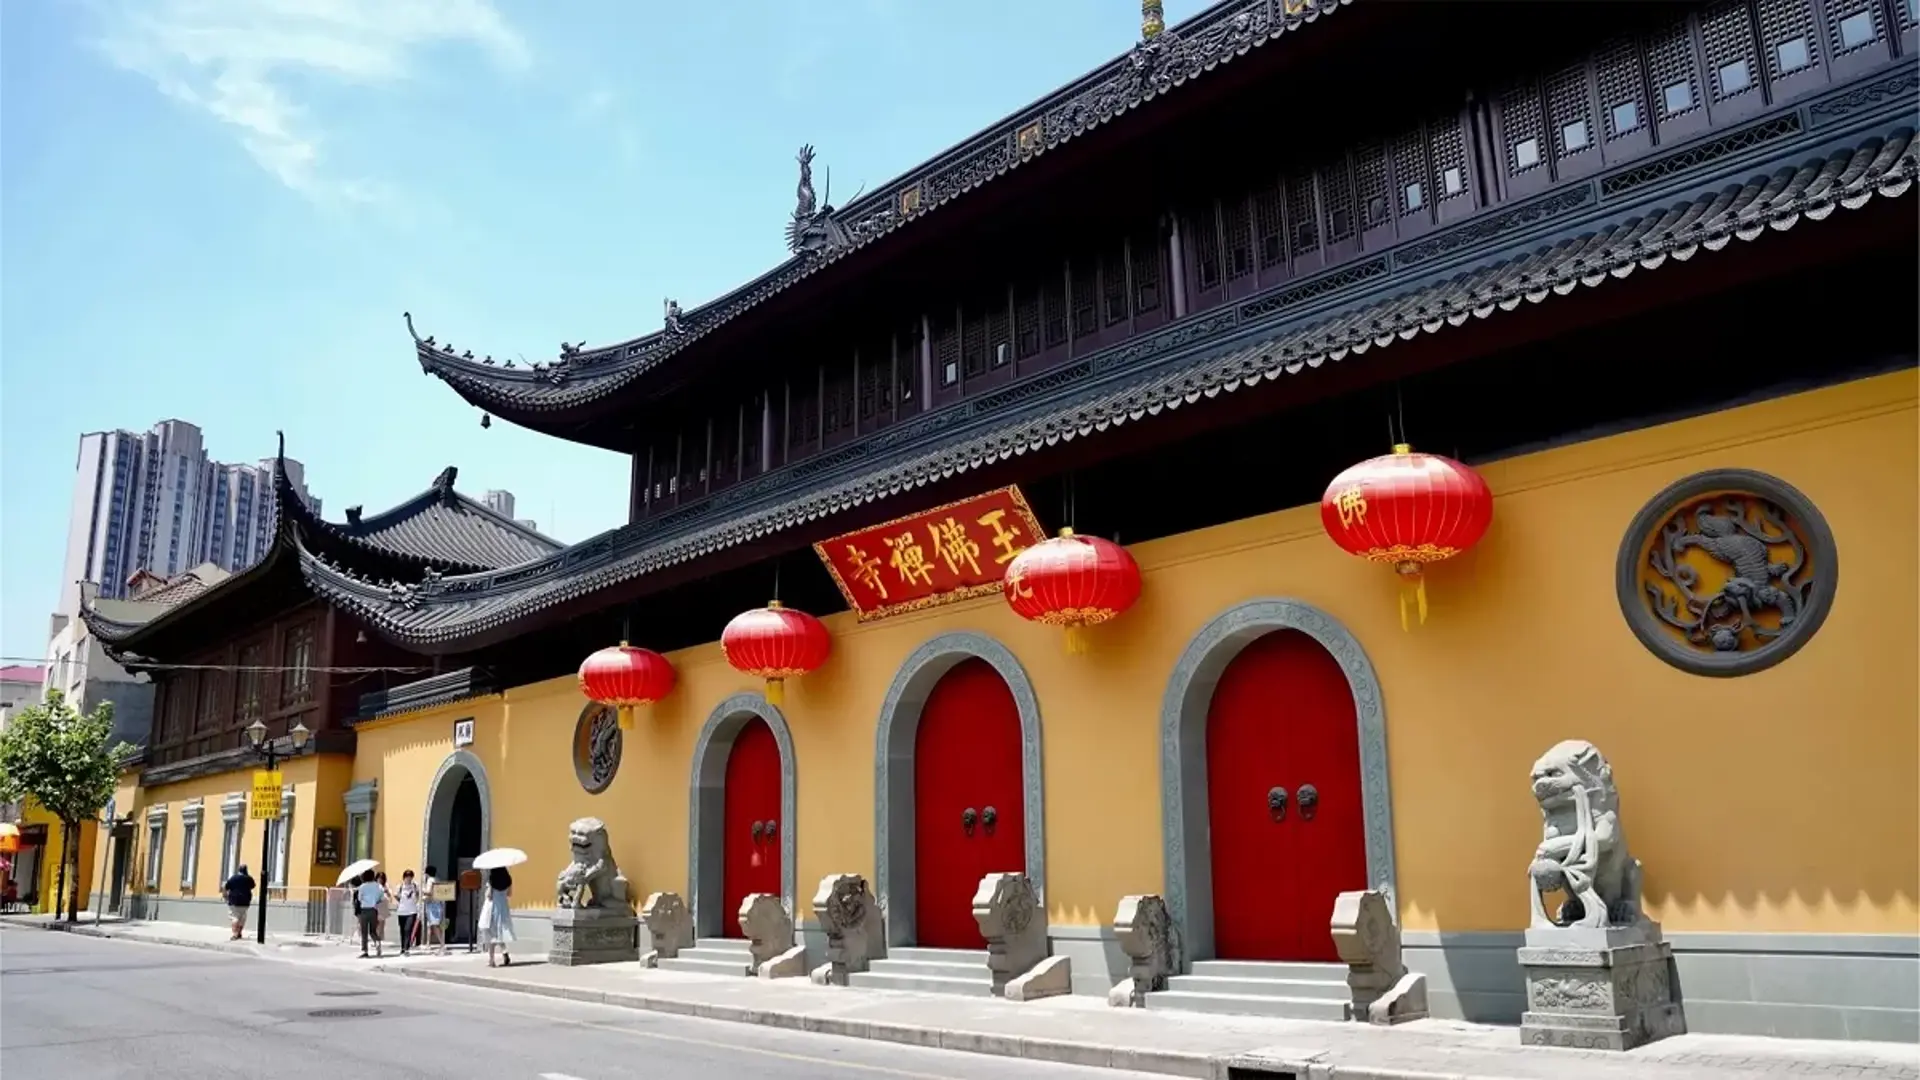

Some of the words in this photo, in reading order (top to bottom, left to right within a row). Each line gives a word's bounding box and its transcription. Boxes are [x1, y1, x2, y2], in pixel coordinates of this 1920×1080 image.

[1332, 484, 1367, 530] 佛
[846, 509, 1025, 599] 玉佛禪寺
